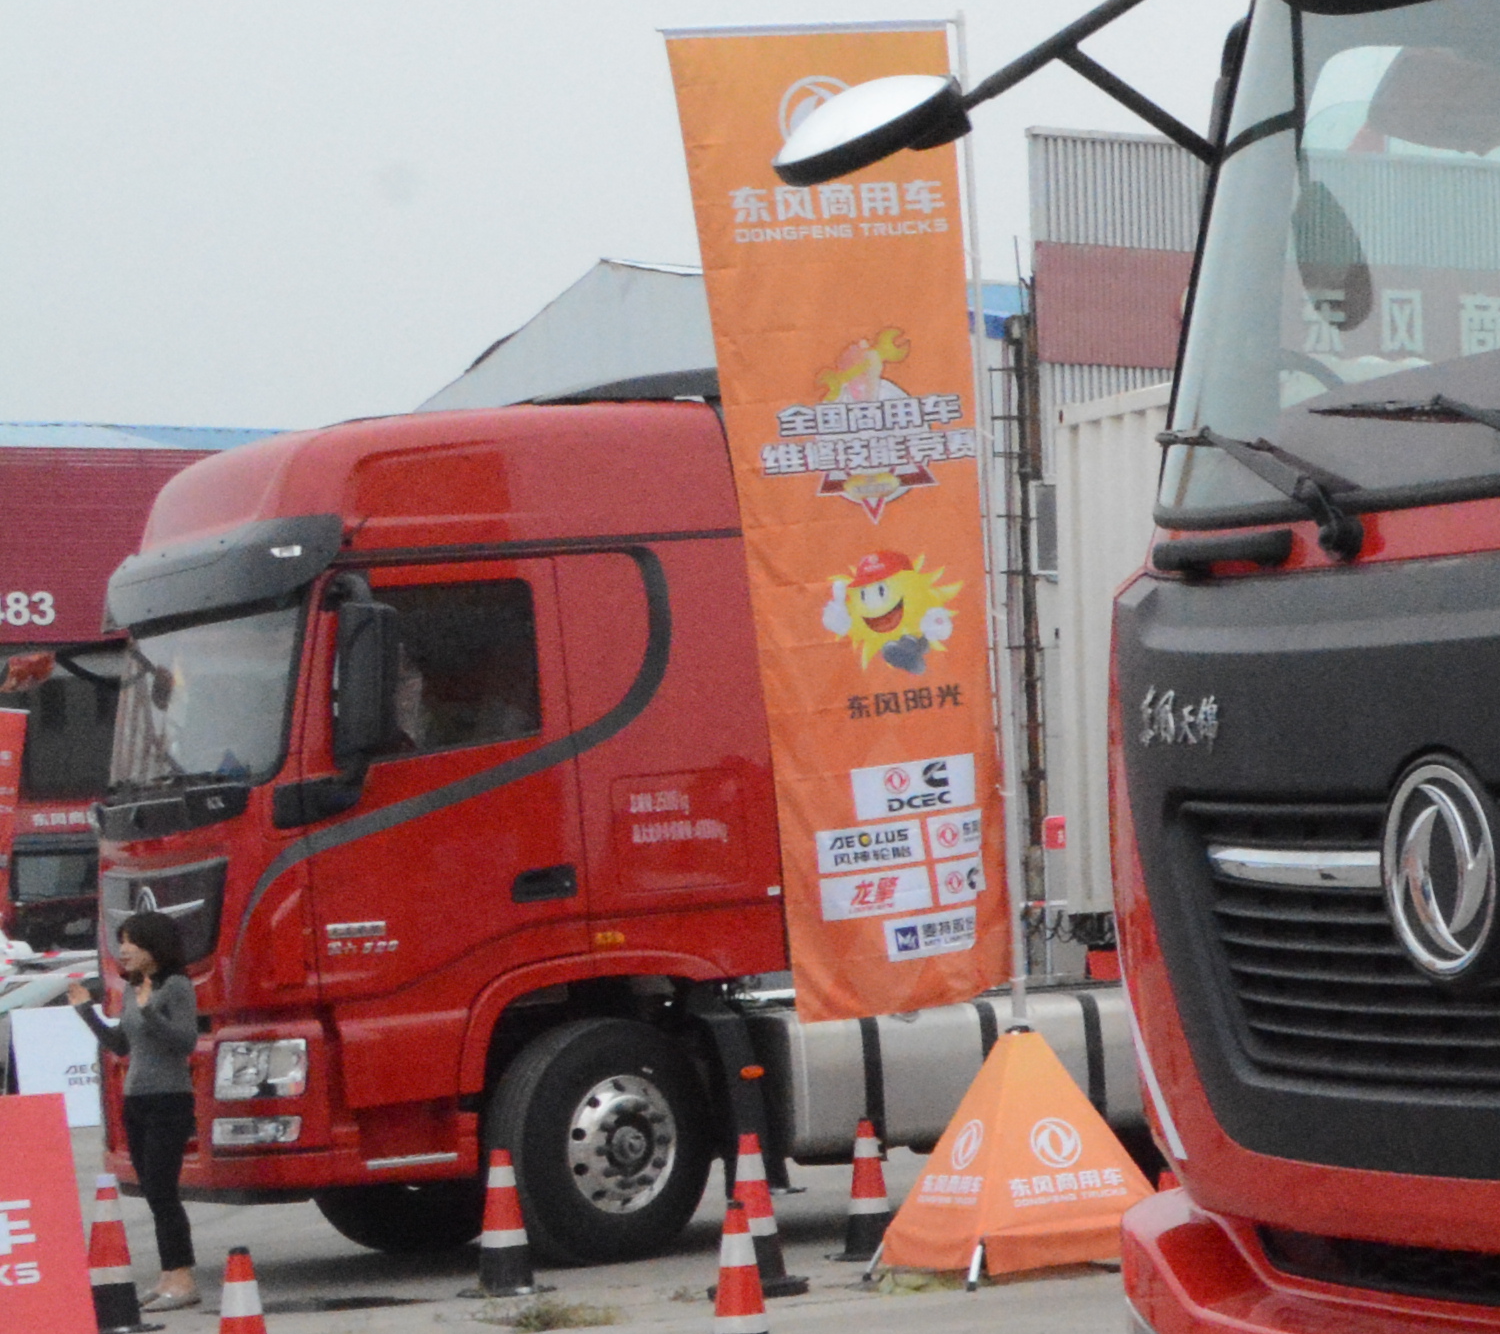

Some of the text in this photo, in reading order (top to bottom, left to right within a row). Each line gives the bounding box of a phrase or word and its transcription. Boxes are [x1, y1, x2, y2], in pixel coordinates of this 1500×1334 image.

[728, 179, 946, 224] 东风商用车
[735, 218, 949, 243] DONGFENG TRUCKS
[776, 395, 964, 437] 全国商用车
[760, 429, 977, 476] 维修技能竞赛
[0, 591, 56, 626] 83
[886, 790, 953, 812] DCEC
[829, 828, 909, 850] AEOLUS
[1008, 1168, 1125, 1198] 东风商用车
